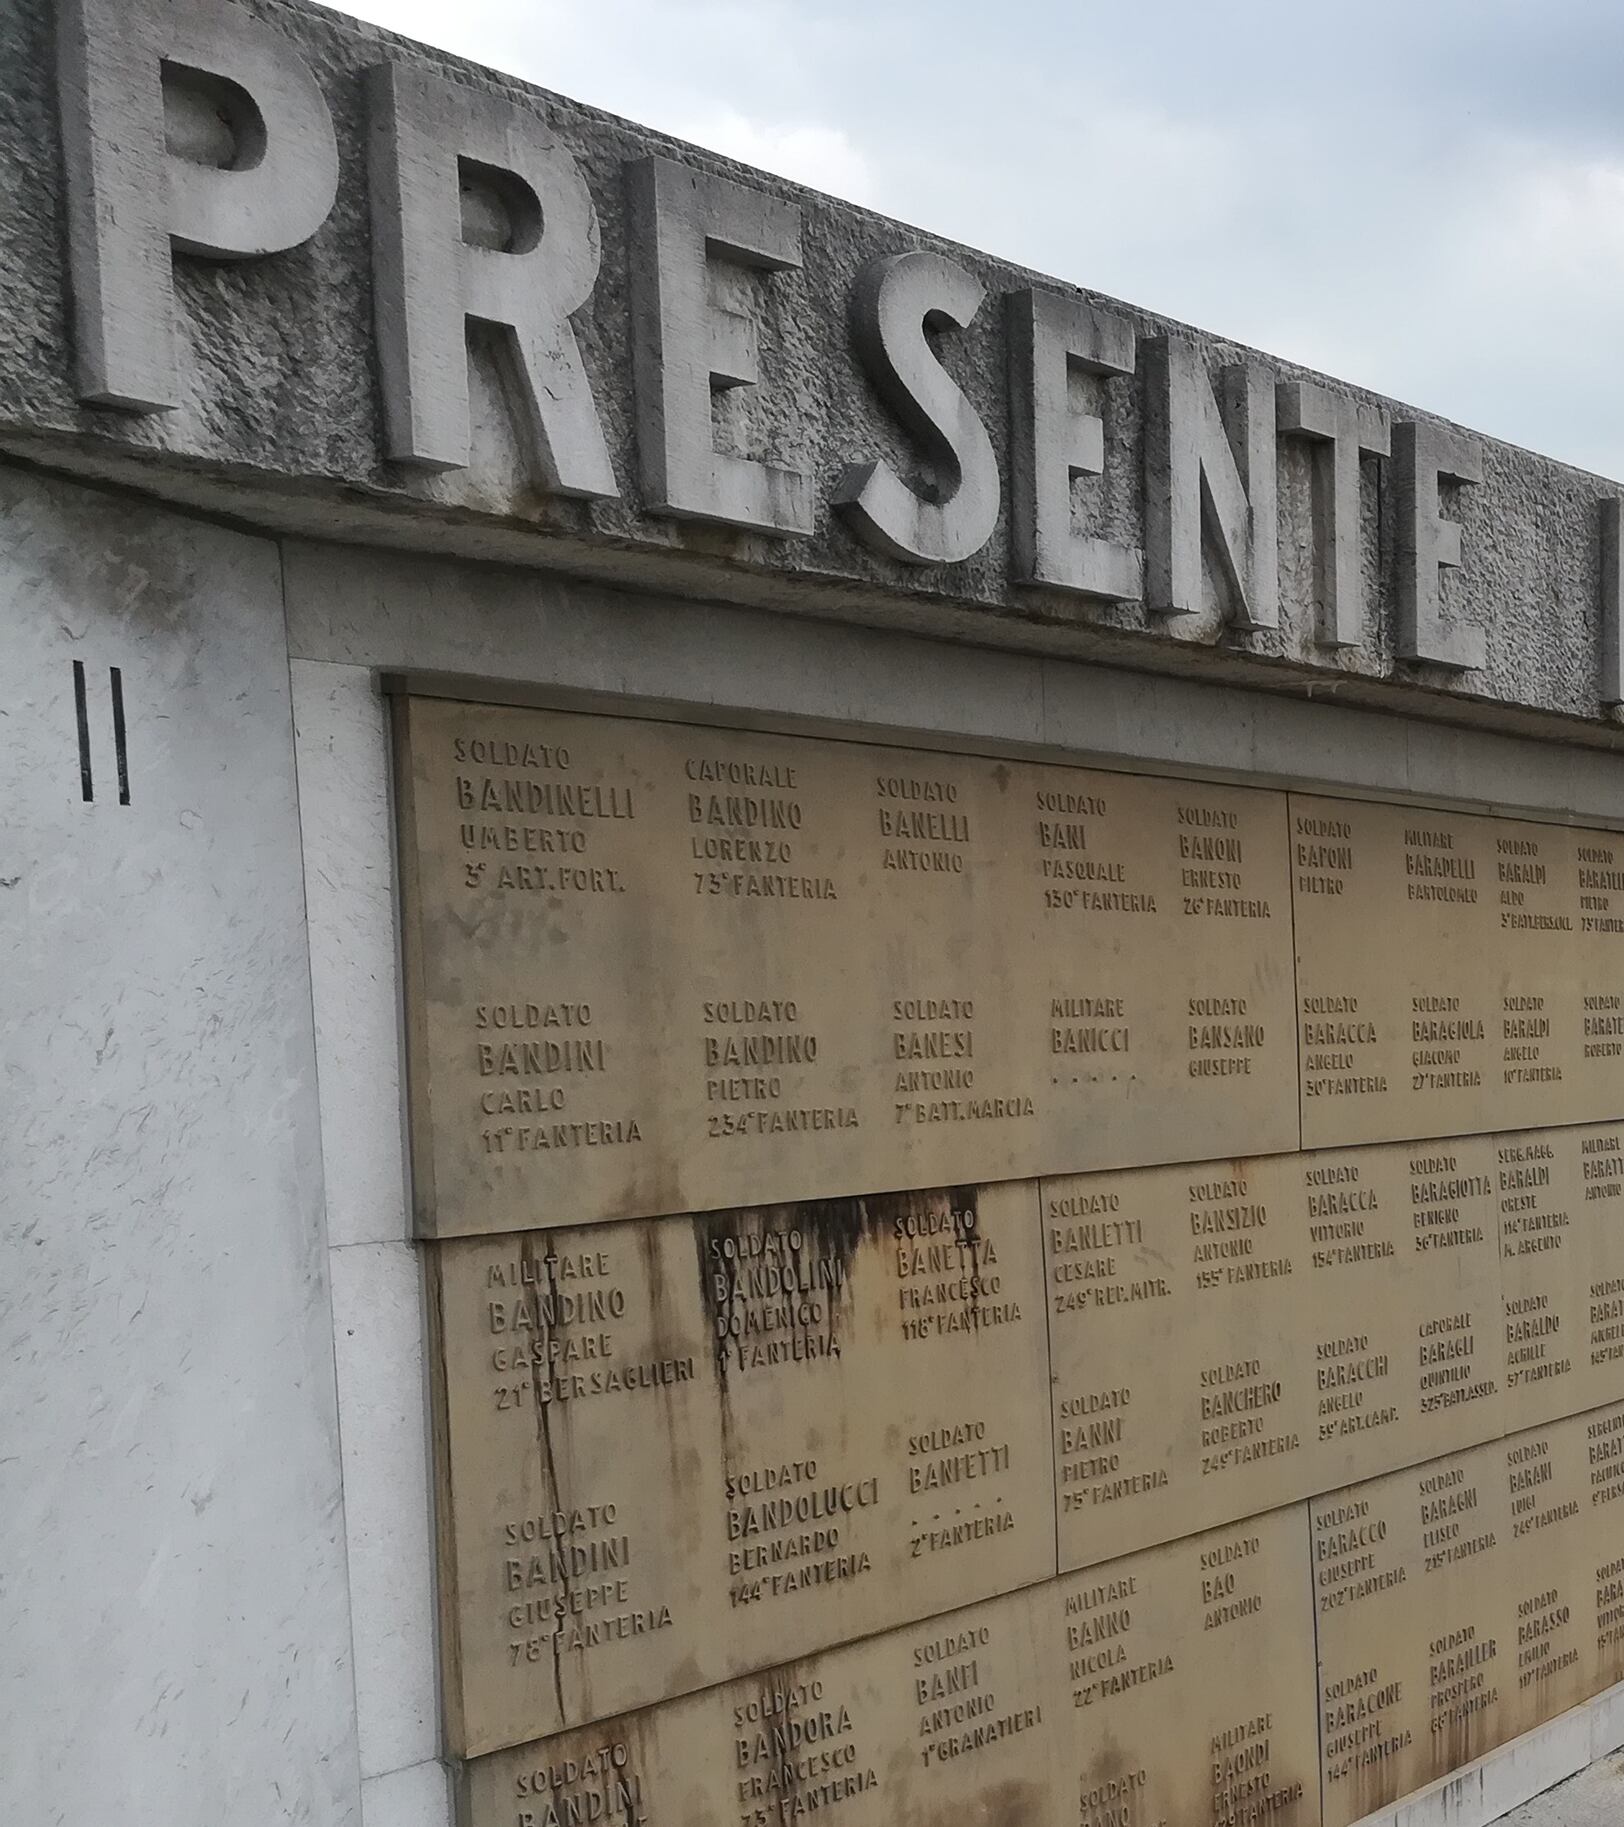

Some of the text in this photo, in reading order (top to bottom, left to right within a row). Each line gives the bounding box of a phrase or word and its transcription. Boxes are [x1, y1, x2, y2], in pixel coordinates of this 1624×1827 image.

[56, 0, 1487, 672] PRESENTE
[453, 737, 571, 770] SOLDATO
[684, 758, 798, 789] CAPORALE
[876, 775, 958, 804] SOLDATO
[456, 775, 636, 820] BANDINELLI
[688, 792, 802, 830] BANDINO
[1036, 791, 1107, 817] SOLDATO
[878, 808, 971, 843] BANELLI
[1177, 806, 1239, 830] SOLDATO
[1296, 816, 1352, 840] SOLDATO
[460, 823, 587, 854] UMBERTO
[692, 836, 793, 864] LORENZO
[1039, 821, 1088, 851] BANI
[1179, 833, 1243, 864] BANONI
[883, 848, 964, 874] ANTONIO
[1042, 859, 1126, 883] PASQUALE
[1182, 867, 1242, 891] ERNESTO
[475, 1002, 592, 1029] SOLDATO
[703, 1000, 798, 1024] SOLDATO
[892, 1000, 974, 1021] SOLDATO
[1050, 998, 1125, 1018] MILITARE
[1188, 998, 1248, 1017] SOLDATO
[1303, 996, 1358, 1014] SOLDATO
[704, 1034, 818, 1067] BANDINO
[893, 1031, 974, 1060] BANESI
[1051, 1027, 1130, 1054] BANICCI
[1189, 1023, 1265, 1050] BANSANO
[477, 1038, 607, 1077] BANDINI
[1188, 1056, 1252, 1078] GIUSEPPE
[706, 1076, 782, 1101] PIETRO
[895, 1069, 975, 1093] ANTONIO
[480, 1085, 566, 1116] CARLO
[516, 1119, 643, 1151] FANTERIA
[1188, 1179, 1248, 1202] SOLDATO
[1305, 1165, 1360, 1187] SOLDATO
[1050, 1192, 1121, 1219] SOLDATO
[895, 1208, 975, 1240] SOLDATO
[710, 1229, 802, 1260] SOLDATO
[897, 1237, 999, 1279] BANETTA
[1193, 1237, 1254, 1264] ANTONIO
[487, 1252, 611, 1289] MILITARE
[713, 1258, 847, 1303] BANDOLINI
[1054, 1256, 1117, 1284] CESARE
[899, 1274, 1002, 1311] FRANCESCO
[488, 1286, 626, 1335] BANDINO
[717, 1302, 823, 1339] DOMENICO
[492, 1332, 614, 1373] GASPARE
[737, 1332, 842, 1372] FANTERIA
[1316, 1334, 1369, 1361] SOLDATO
[540, 1357, 695, 1405] BERSAGLIERI
[1199, 1358, 1262, 1388] SOLDATO
[1060, 1386, 1132, 1420] SOLDATO
[908, 1421, 986, 1456] SOLDATO
[1061, 1416, 1124, 1456] BANNI
[1201, 1415, 1265, 1448] ROBERTO
[725, 1459, 818, 1501] SOLDATO
[1062, 1453, 1121, 1483] PIETRO
[504, 1502, 618, 1546] SOLDATO
[727, 1476, 880, 1542] BANDOLUCCI
[1316, 1500, 1370, 1532] SOLDATO
[506, 1535, 630, 1592] BANDINI
[728, 1527, 840, 1576] BERNARDO
[1200, 1536, 1261, 1572] SOLDATO
[508, 1578, 629, 1629] GIUSEPPE
[1065, 1575, 1138, 1617] MILITARE
[1201, 1571, 1236, 1605] BAO
[1066, 1607, 1132, 1652] BANNO
[1202, 1594, 1263, 1632] ANTONIO
[552, 1604, 674, 1657] FANTERIA
[913, 1625, 991, 1668] SOLDATO
[1069, 1643, 1128, 1682] NICOLA
[1324, 1667, 1379, 1704] SOLDATO
[731, 1679, 824, 1728] SOLDATO
[918, 1692, 996, 1737] ANTONIO
[734, 1703, 854, 1770] BANDORA
[1210, 1711, 1274, 1756] MILITARE
[516, 1743, 629, 1799] SOLDATO
[736, 1743, 857, 1803] FRANCESCO
[1079, 1768, 1149, 1813] SOLDATO
